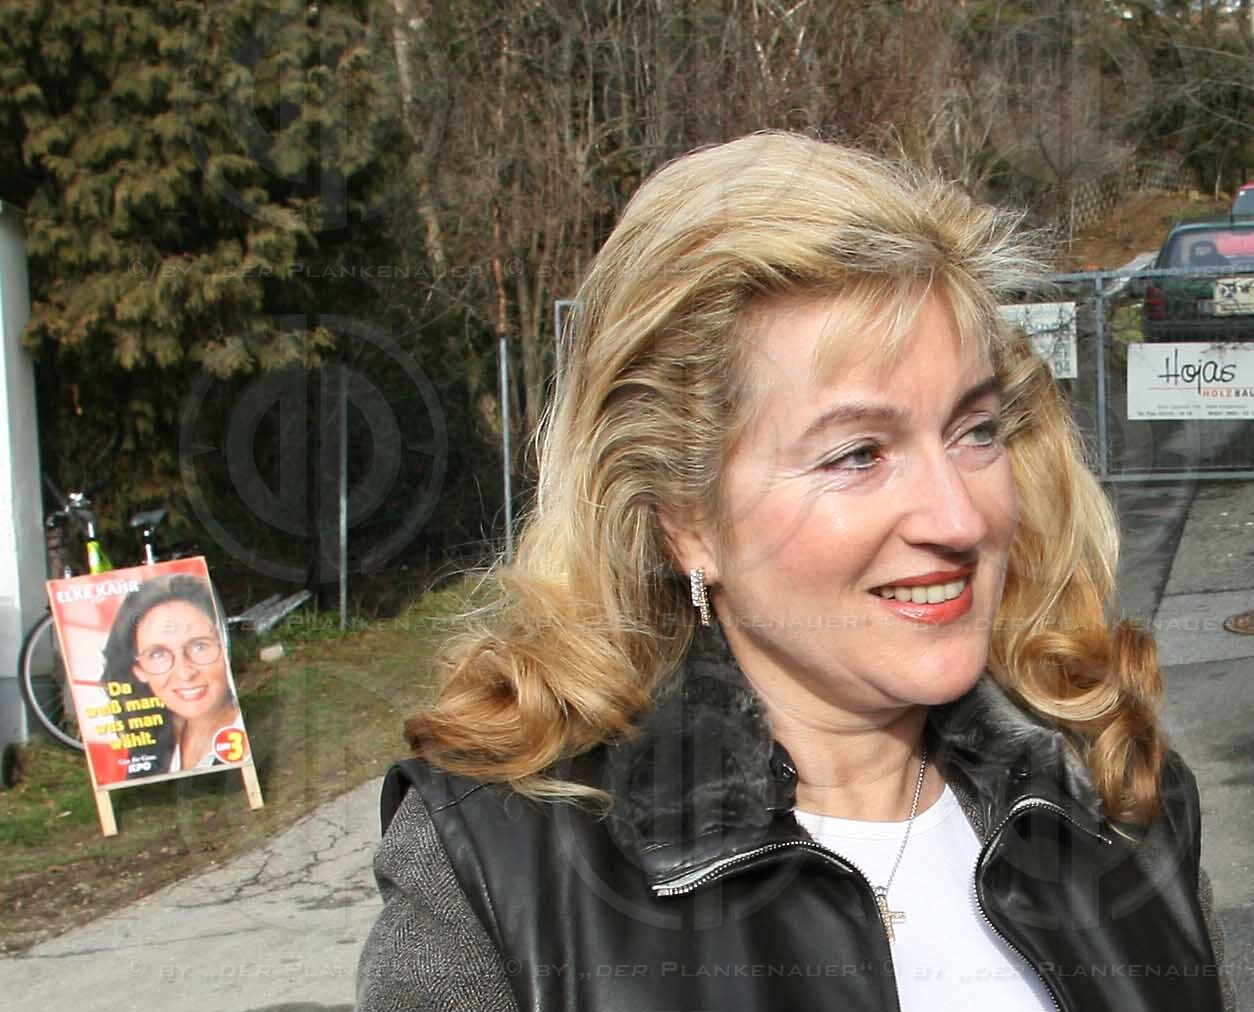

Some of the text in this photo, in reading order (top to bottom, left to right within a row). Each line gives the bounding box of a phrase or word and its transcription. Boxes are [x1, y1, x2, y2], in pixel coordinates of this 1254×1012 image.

[1157, 347, 1238, 395] Hojas
[107, 681, 133, 697] Da
[128, 713, 164, 730] man
[227, 731, 244, 761] 3
